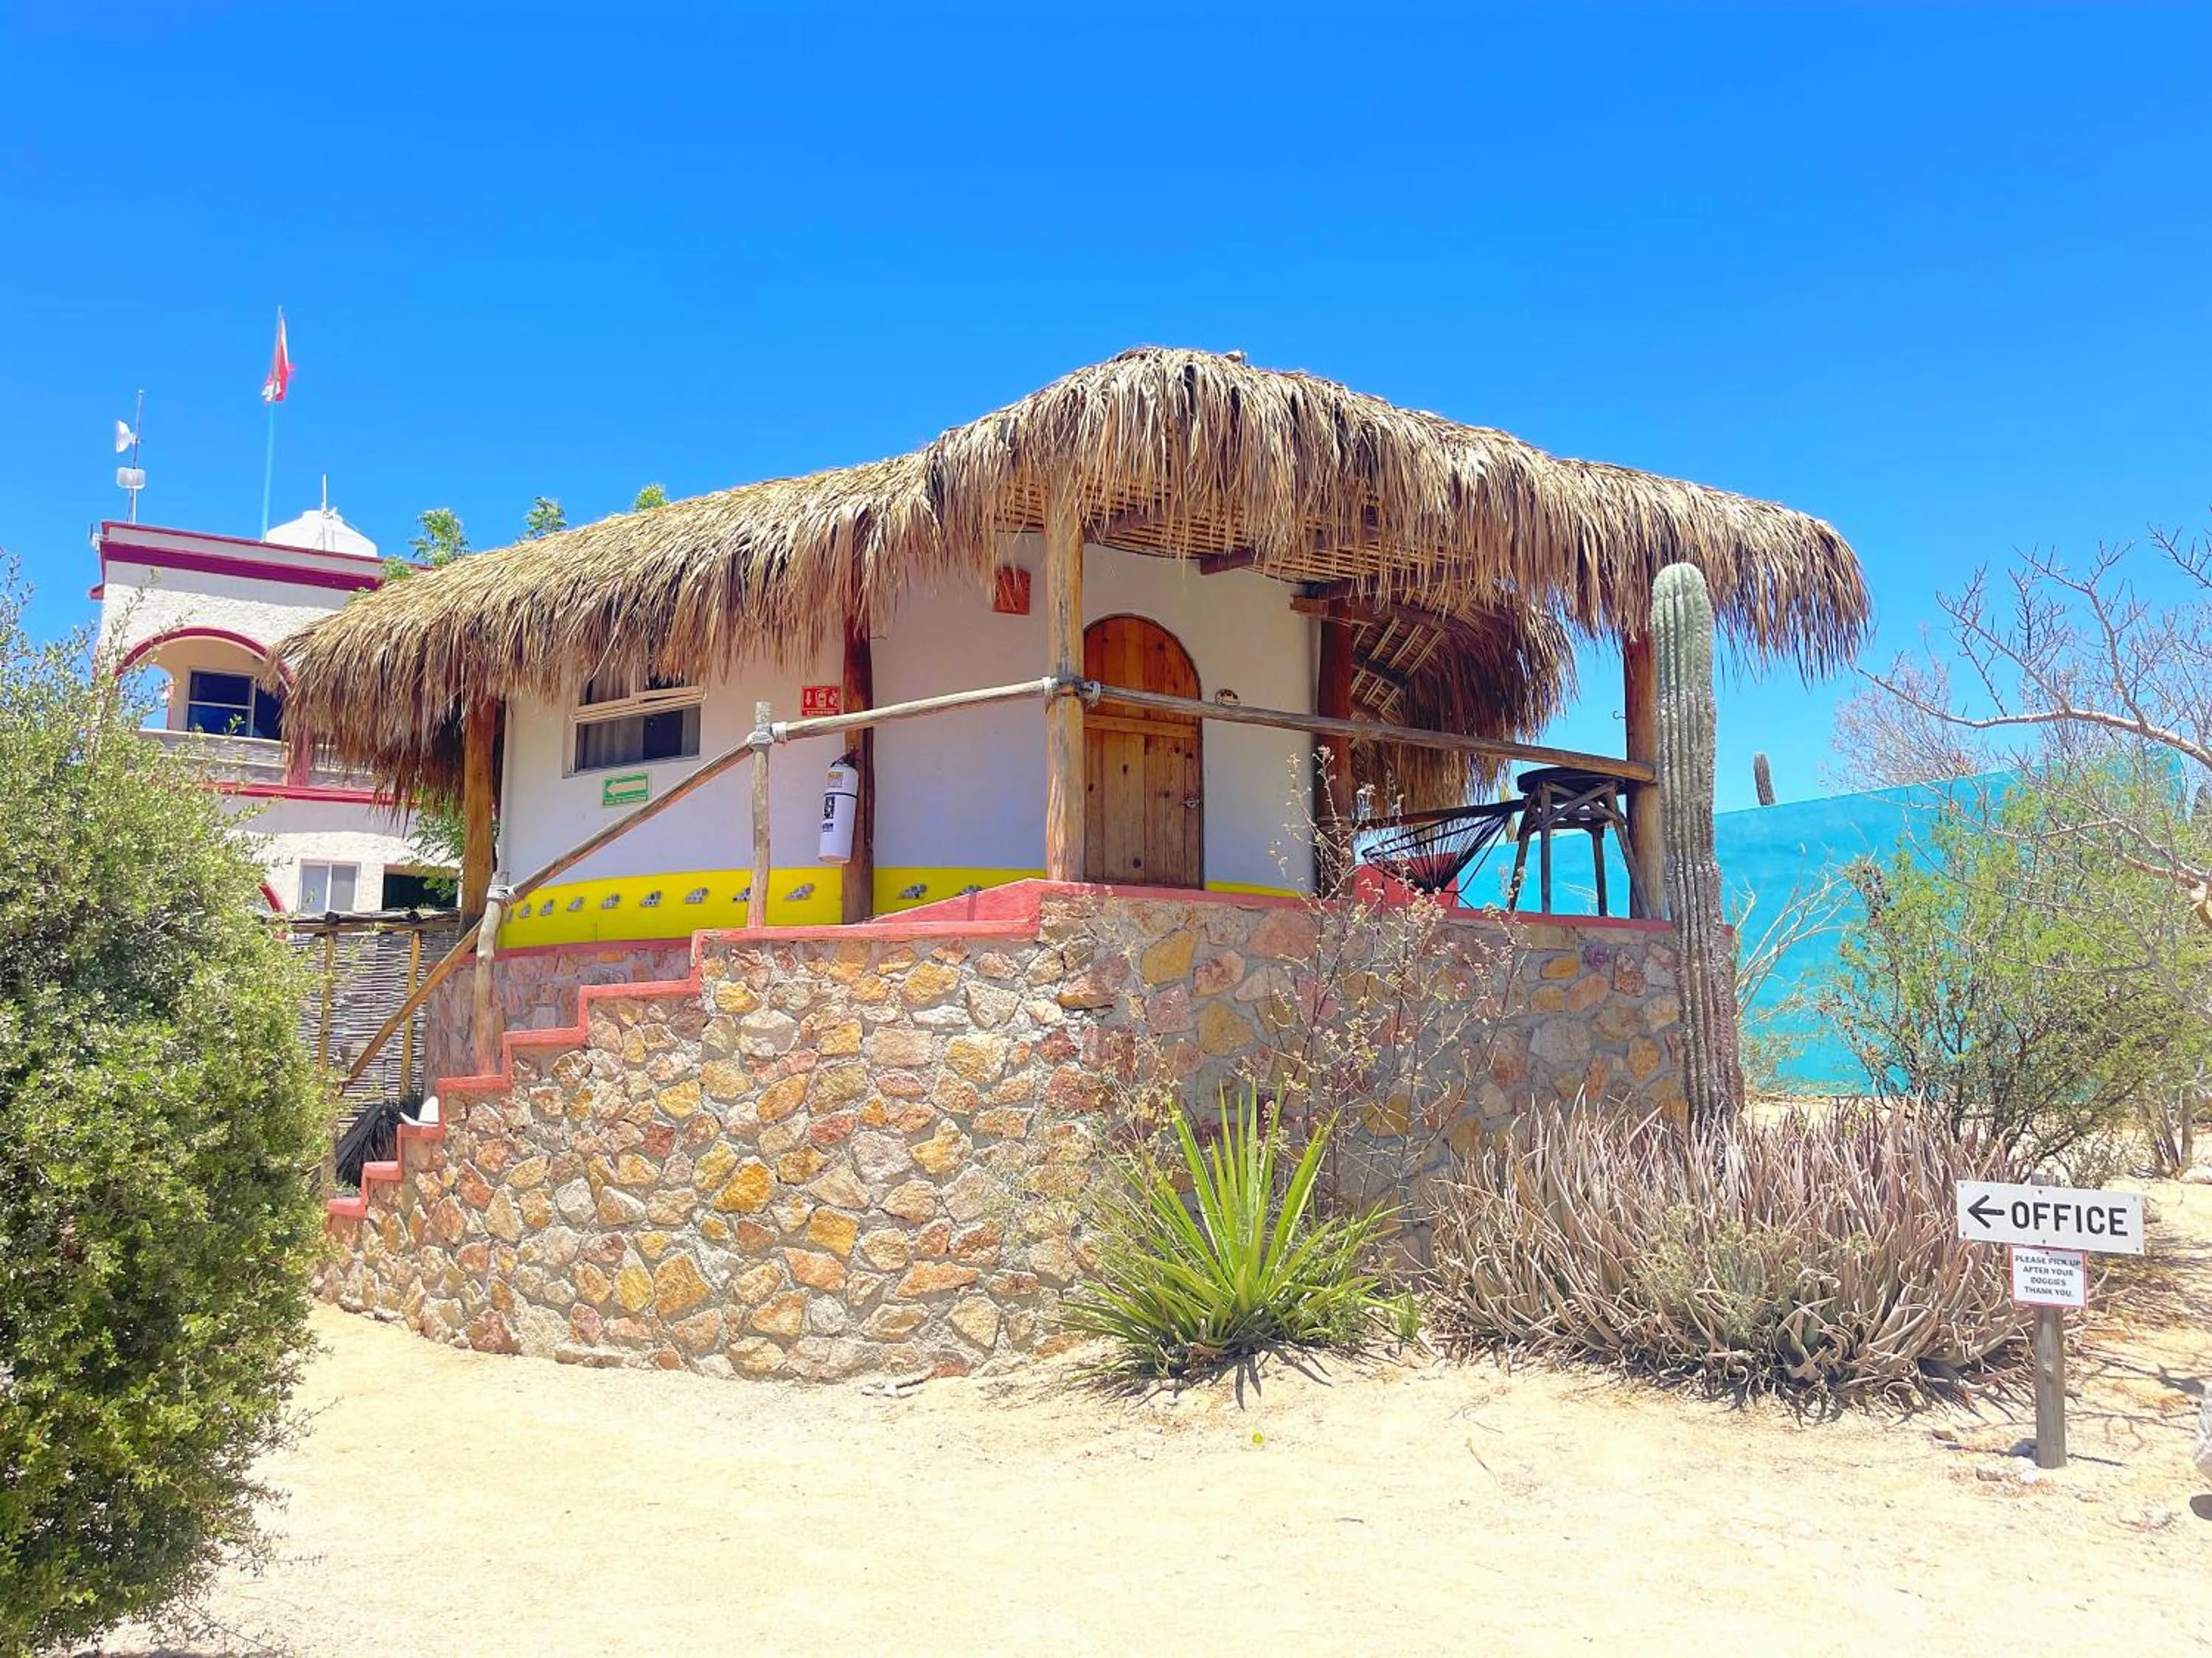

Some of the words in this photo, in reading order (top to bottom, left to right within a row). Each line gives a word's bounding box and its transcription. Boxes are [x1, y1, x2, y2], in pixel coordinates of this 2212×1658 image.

[2011, 1201, 2128, 1236] OFFICE
[2014, 1255, 2047, 1264] PLEASE
[2023, 1266, 2049, 1274] AFTER
[2051, 1269, 2074, 1277] YOUR
[2030, 1277, 2067, 1286] DOGGIES
[2024, 1286, 2053, 1295] THANK
